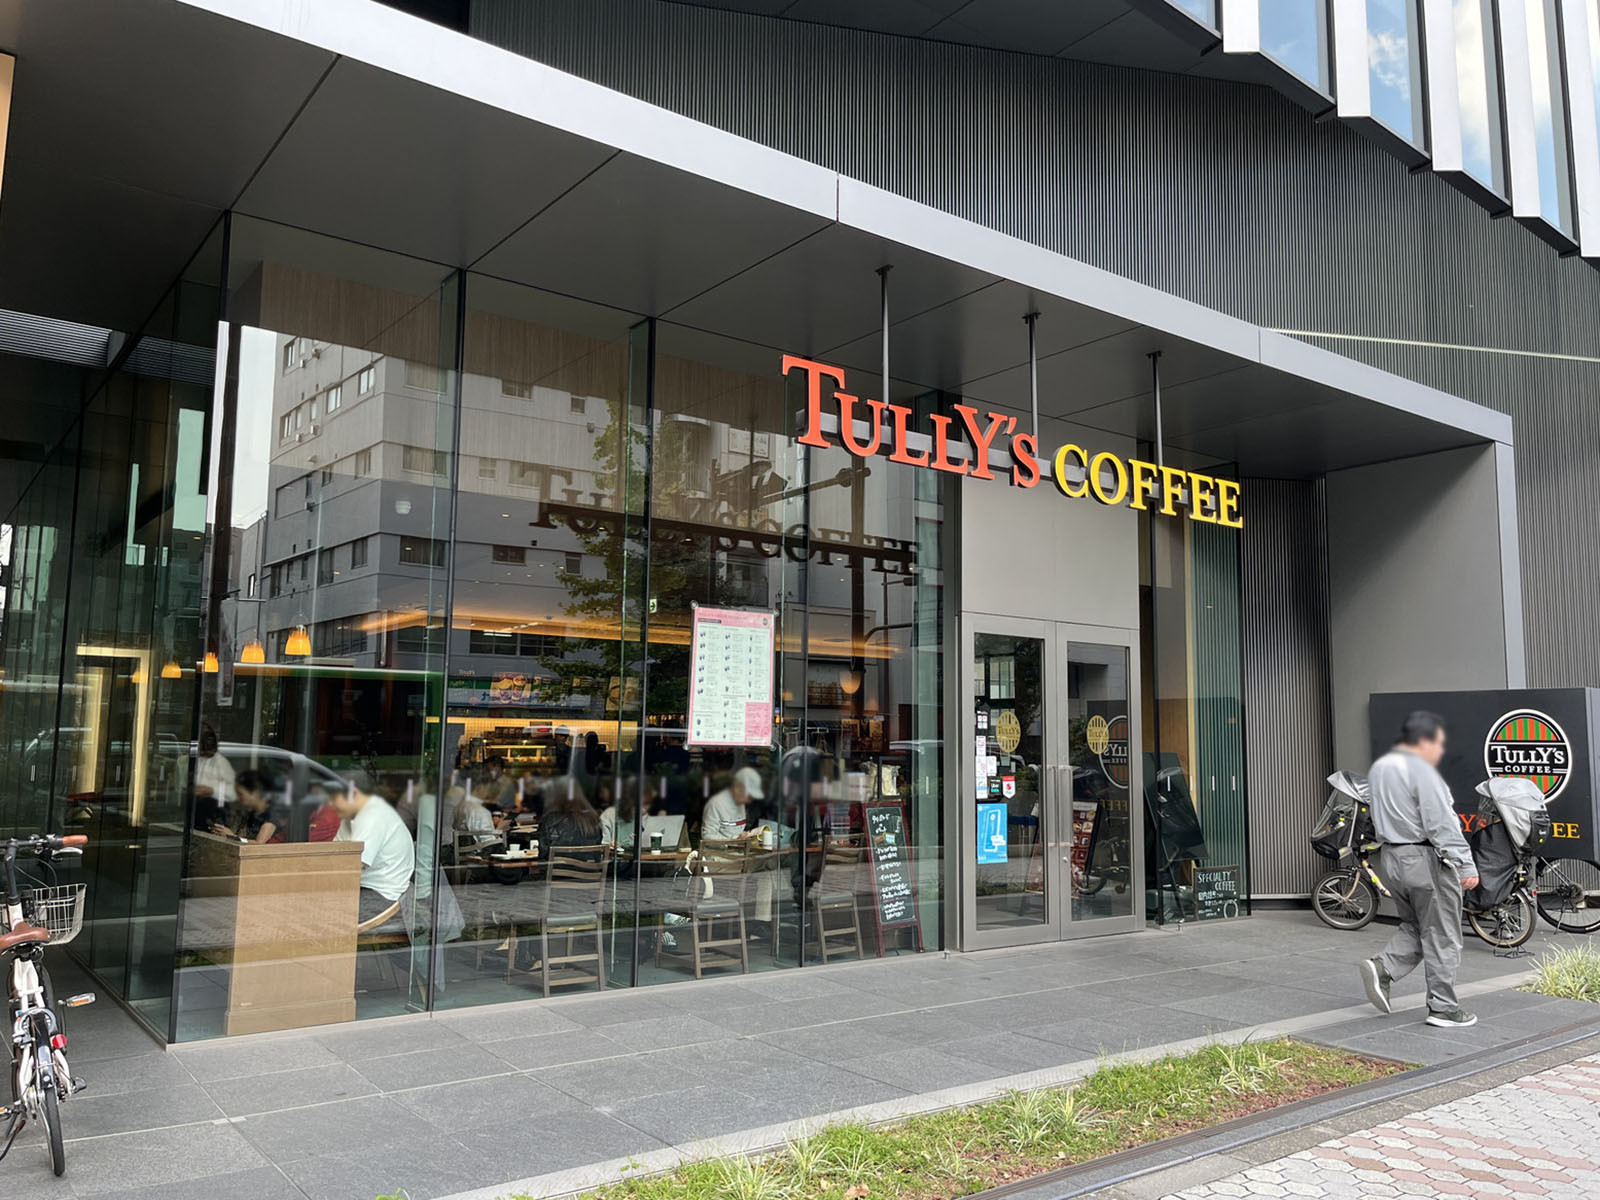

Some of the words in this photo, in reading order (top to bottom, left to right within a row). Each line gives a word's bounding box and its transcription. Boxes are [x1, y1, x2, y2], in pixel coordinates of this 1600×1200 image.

[781, 354, 1042, 488] TULLY'S
[1054, 443, 1244, 529] COFFEE
[1490, 745, 1565, 764] TULLY'S
[1504, 765, 1551, 774] COFFEE
[1198, 871, 1231, 883] SPECIALTY
[1215, 881, 1236, 891] COFFEE
